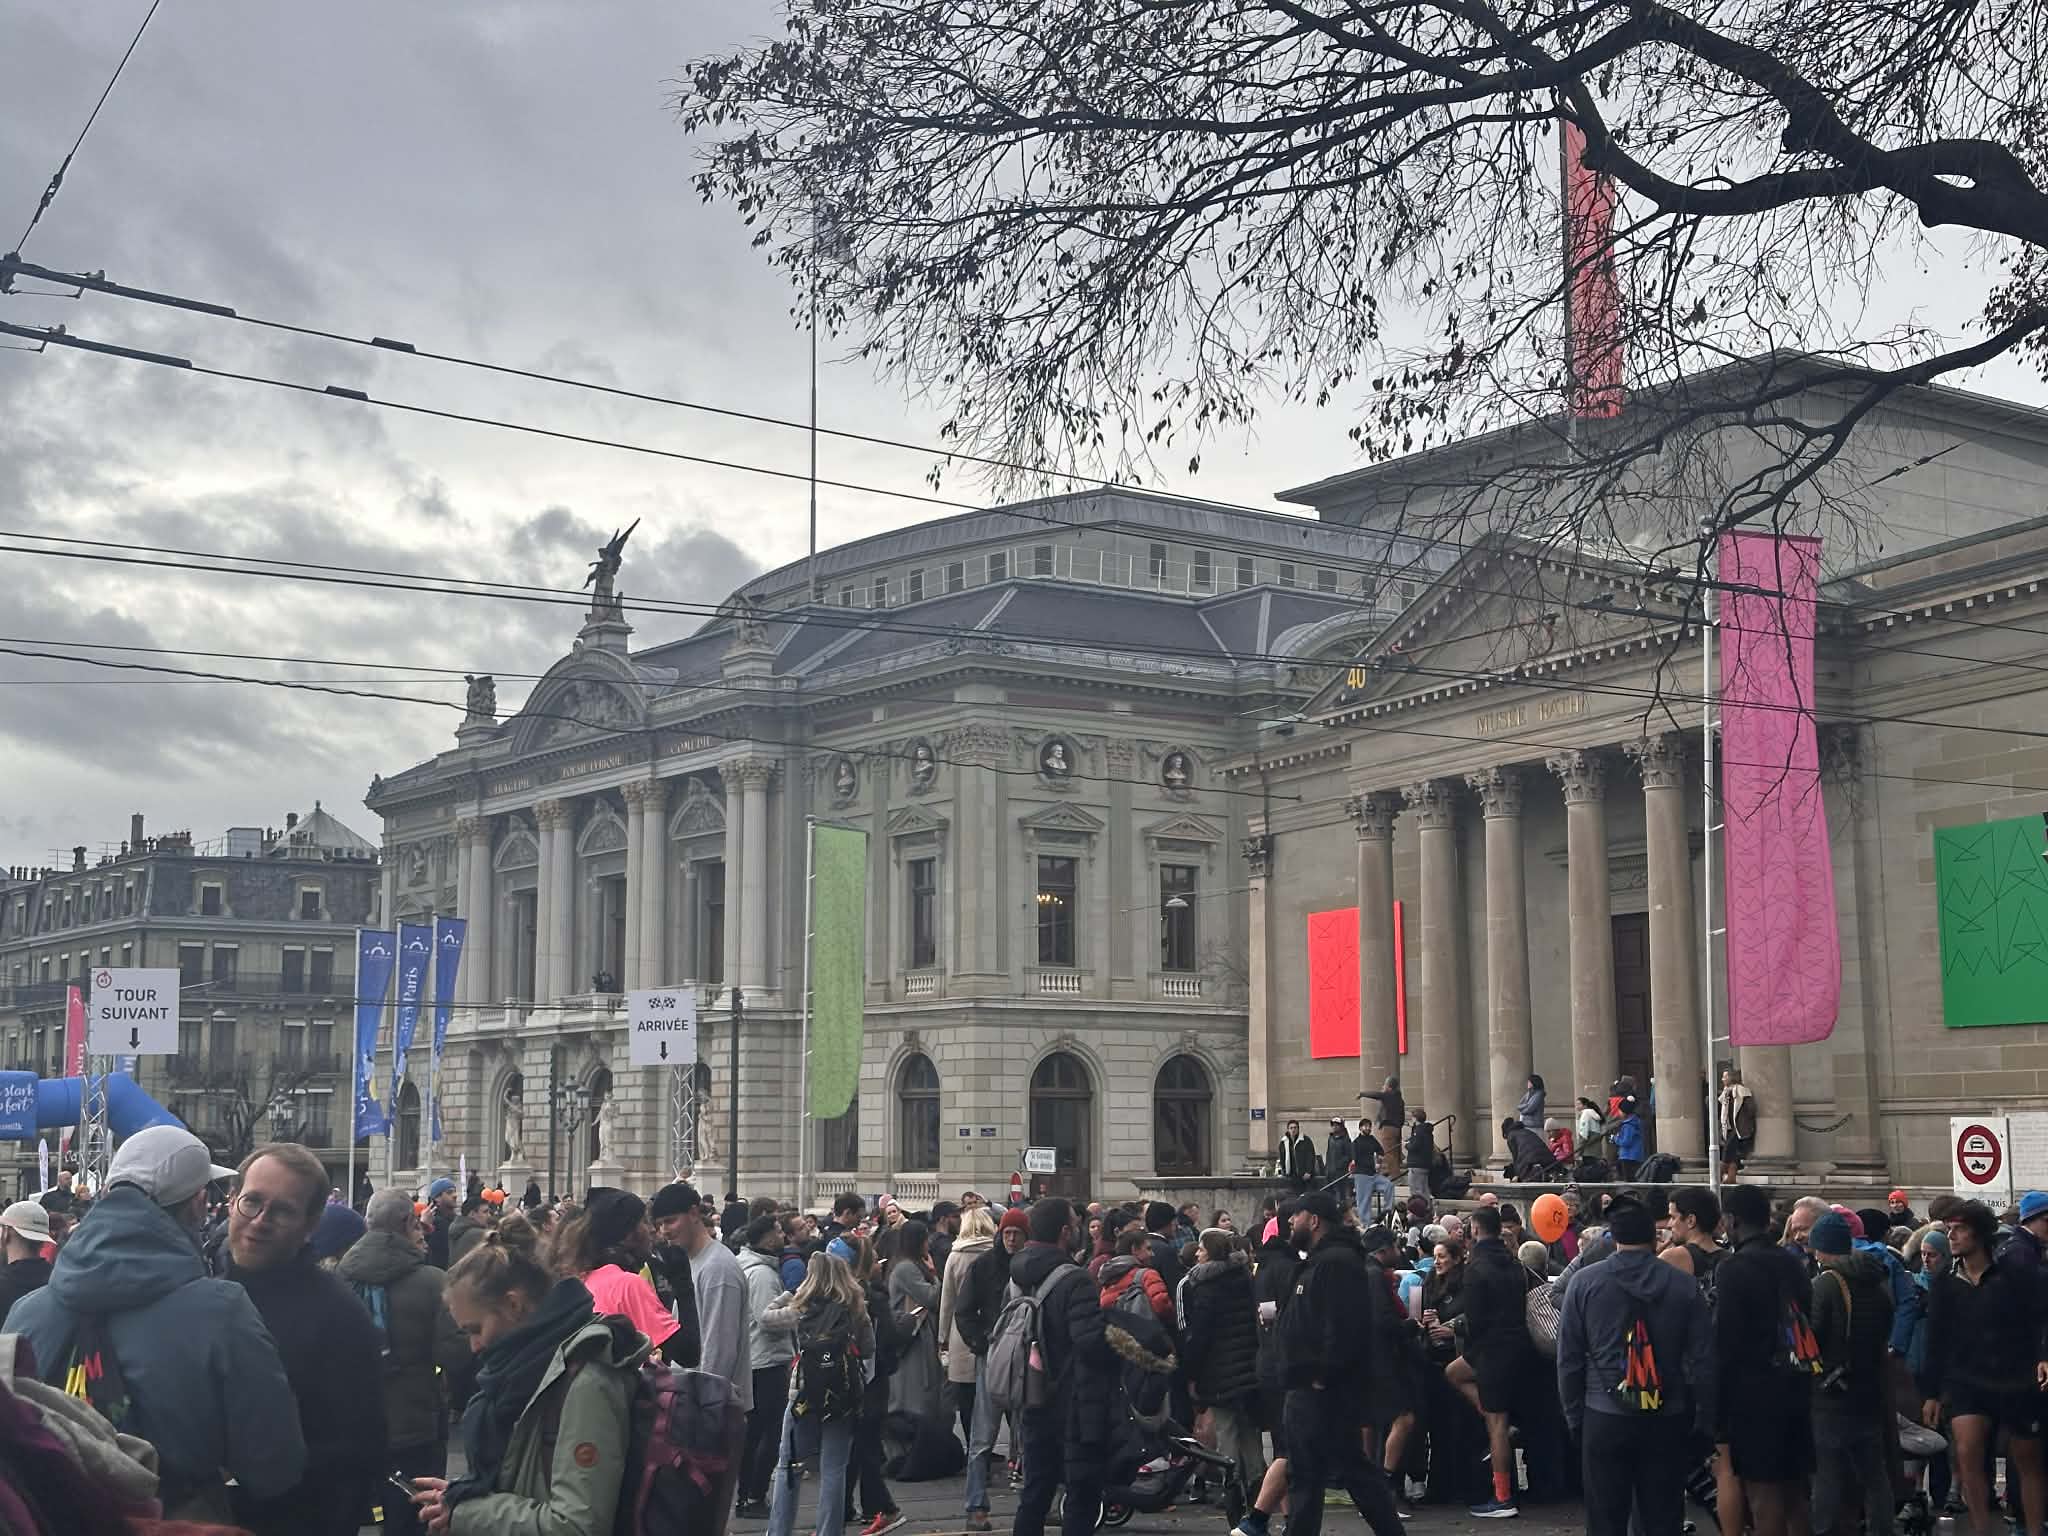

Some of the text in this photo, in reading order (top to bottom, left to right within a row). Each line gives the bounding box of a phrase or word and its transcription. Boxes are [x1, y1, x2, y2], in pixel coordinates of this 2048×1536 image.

[1348, 664, 1365, 688] 40
[402, 967, 418, 1002] Paris
[115, 989, 157, 1001] TOUR
[101, 1007, 169, 1020] SUIVANT
[638, 1018, 689, 1032] ARRIVÉE
